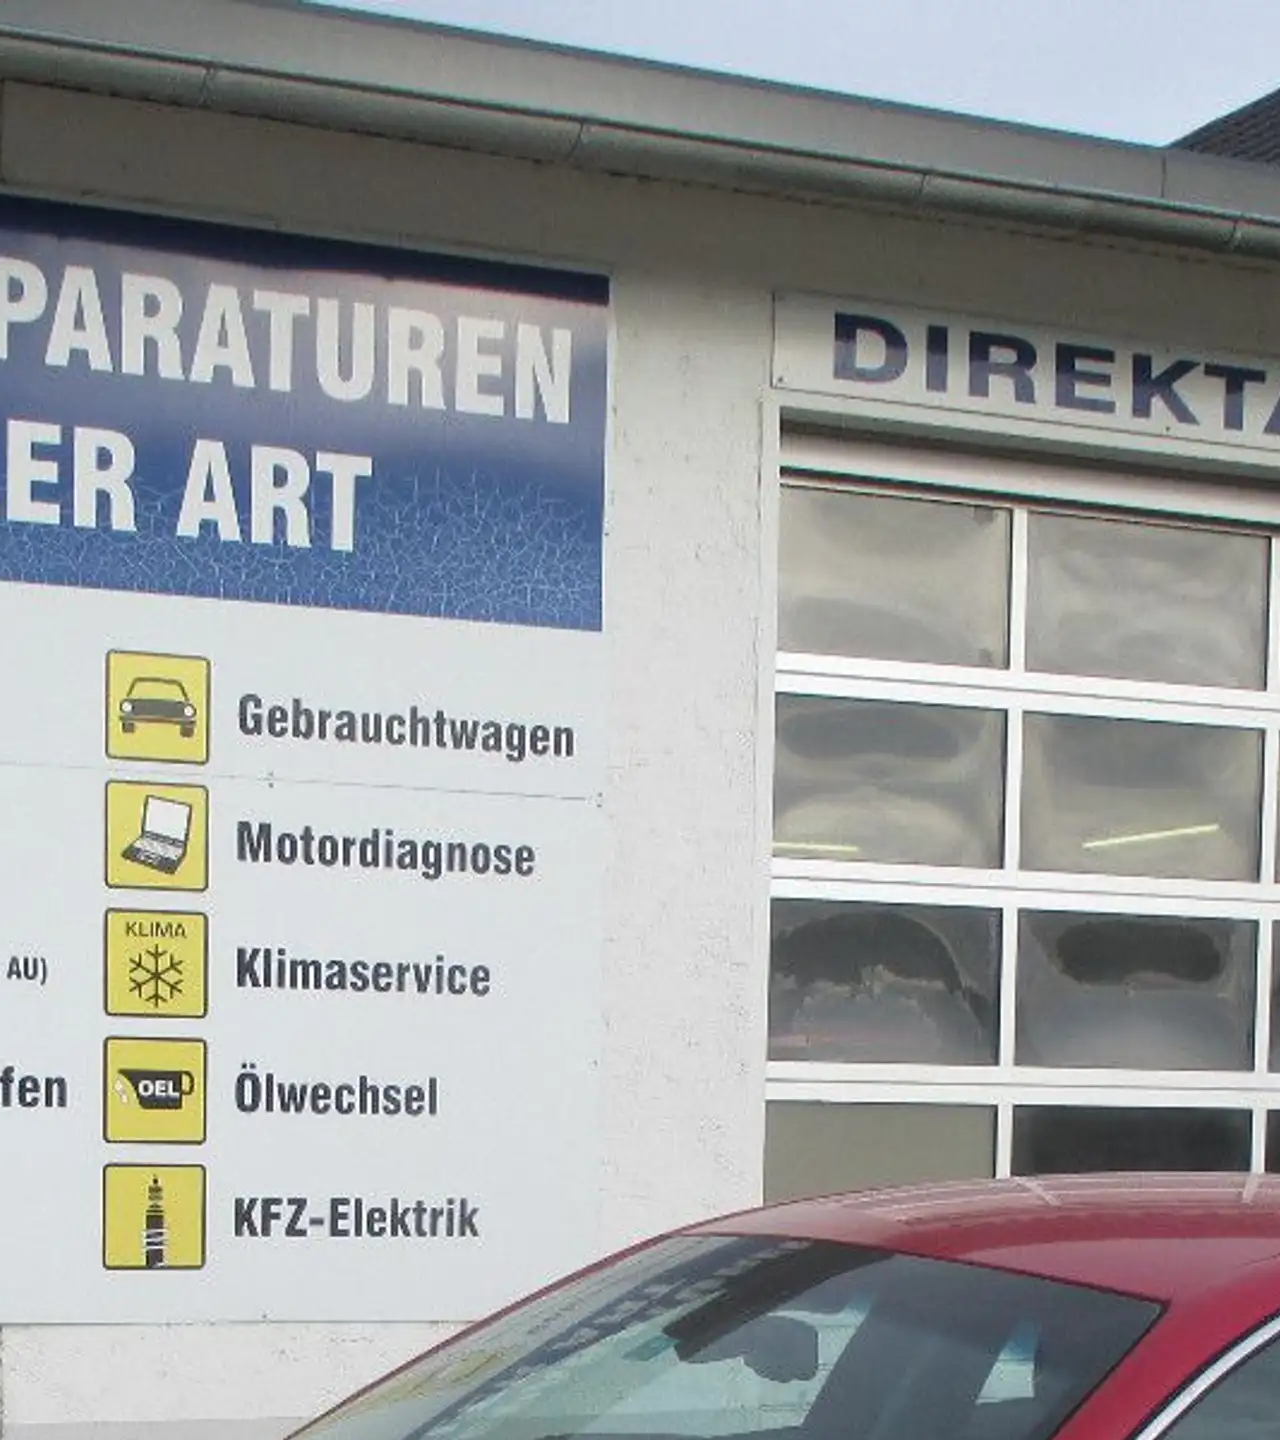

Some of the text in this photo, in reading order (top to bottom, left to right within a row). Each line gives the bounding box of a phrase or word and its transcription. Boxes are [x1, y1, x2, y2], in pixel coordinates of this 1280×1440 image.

[176, 439, 373, 554] ART
[238, 693, 575, 762] Gebrauchtwagen
[237, 820, 536, 880] Motordiagnose
[125, 920, 187, 940] KLIMA
[6, 956, 49, 986] AU)
[236, 947, 491, 997] Klimaservice
[138, 1077, 180, 1097] OEL
[235, 1062, 438, 1116] Ölwechsel
[233, 1197, 480, 1239] KFZ-Elektrik
